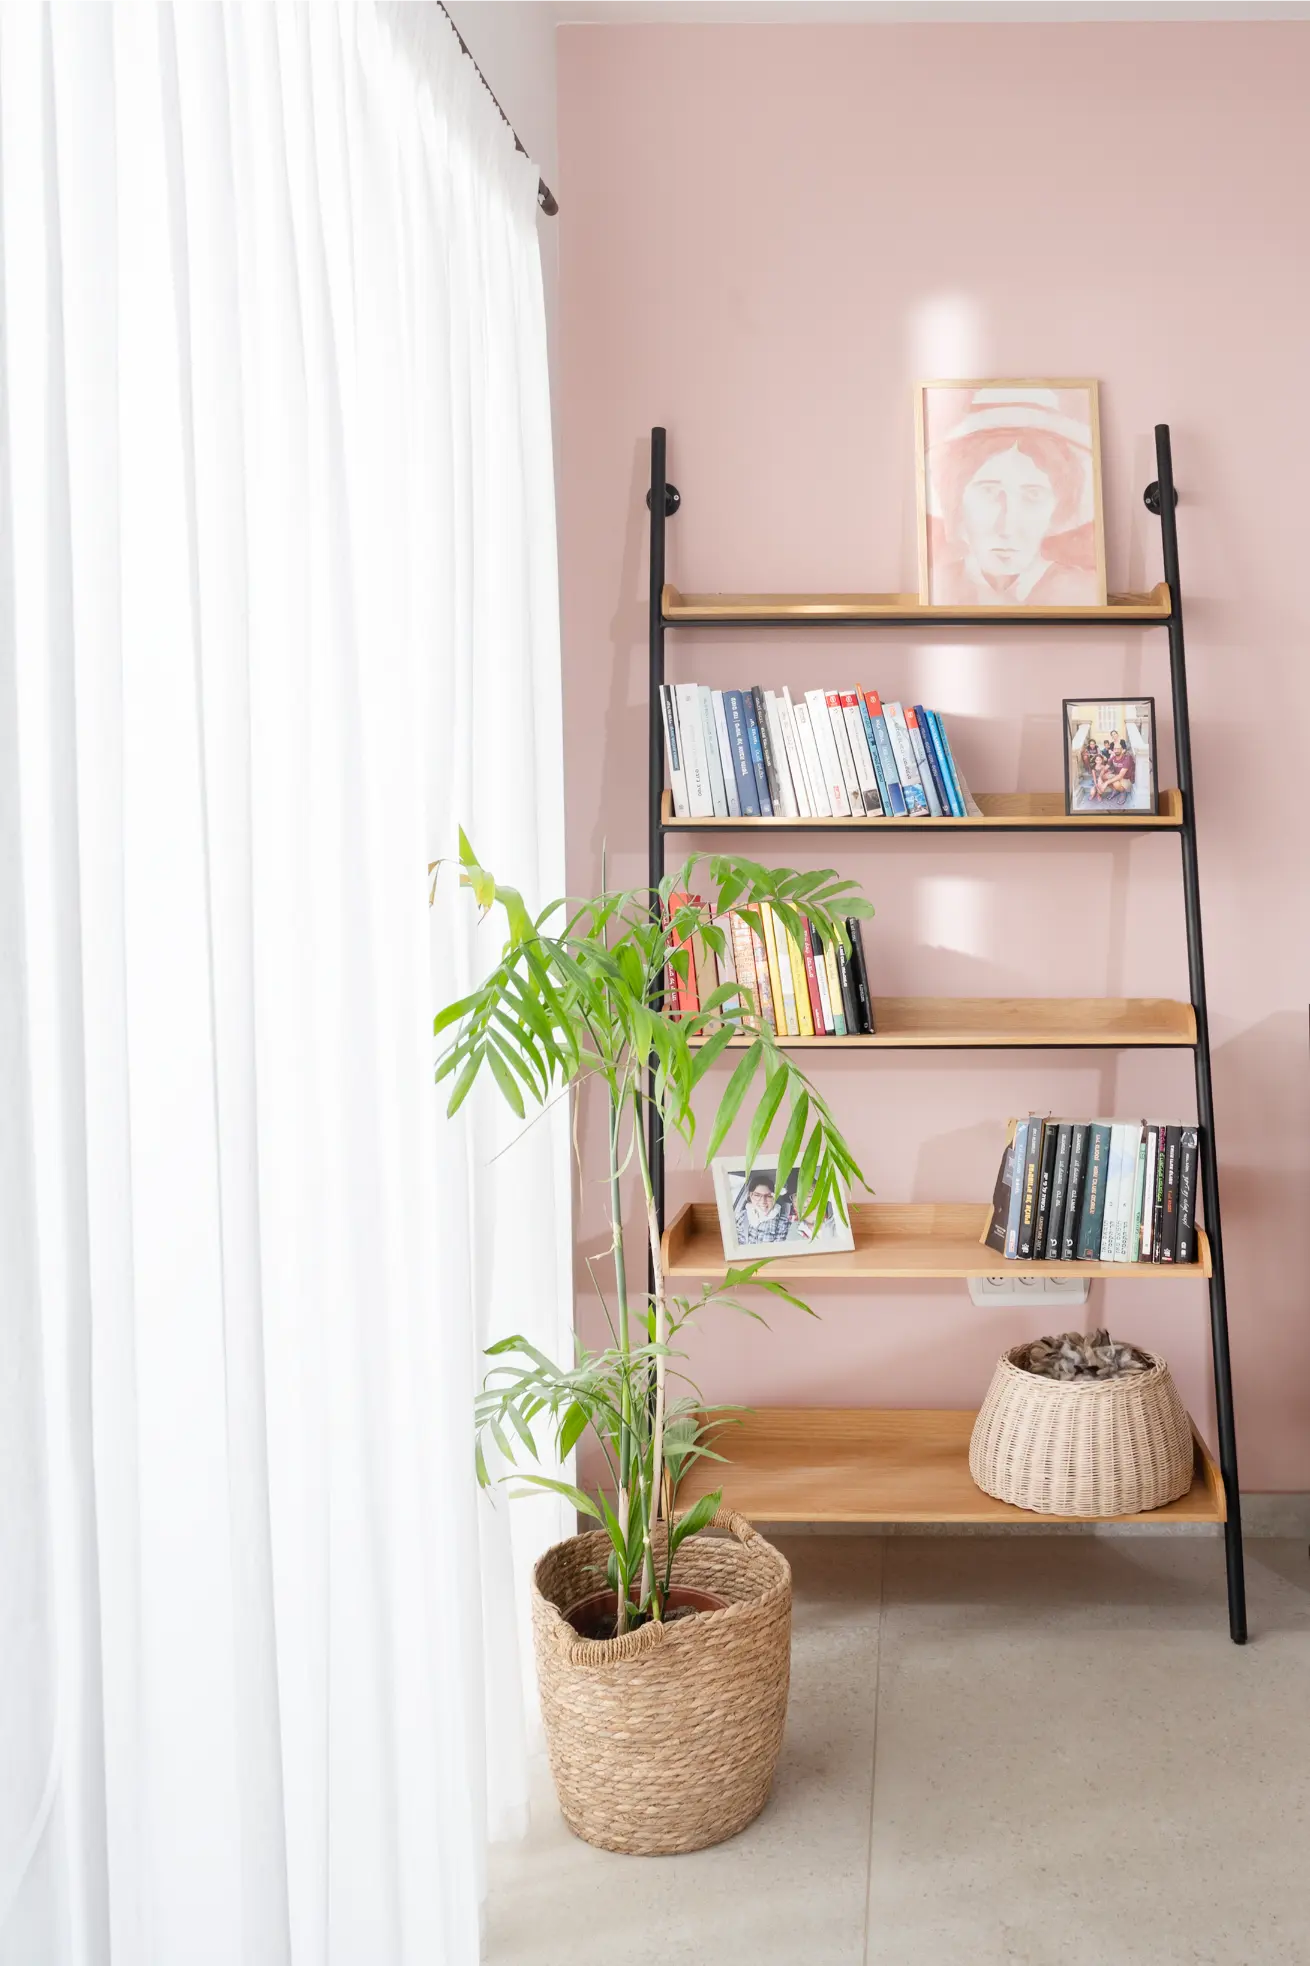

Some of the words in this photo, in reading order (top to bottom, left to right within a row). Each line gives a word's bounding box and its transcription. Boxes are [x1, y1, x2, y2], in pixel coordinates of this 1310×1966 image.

[730, 697, 738, 710] עמוס
[736, 737, 743, 746] על
[740, 760, 749, 776] וחושך
[1042, 1186, 1048, 1194] על
